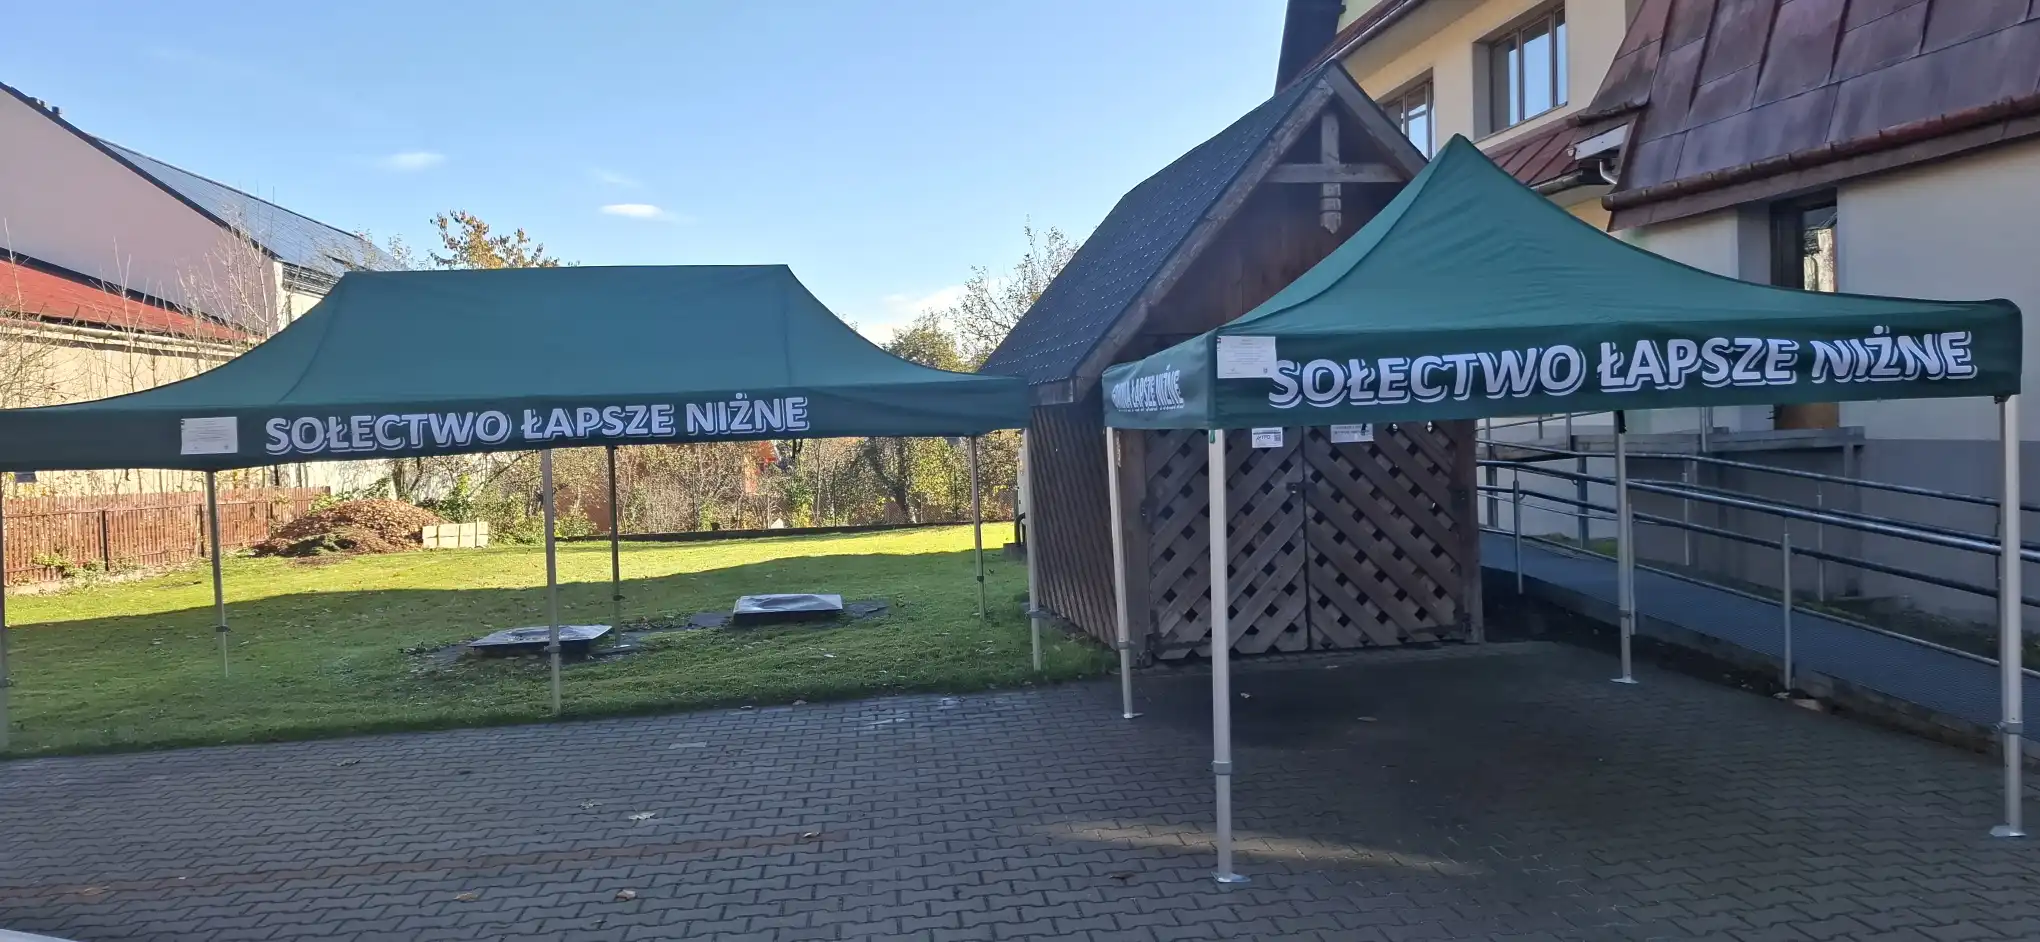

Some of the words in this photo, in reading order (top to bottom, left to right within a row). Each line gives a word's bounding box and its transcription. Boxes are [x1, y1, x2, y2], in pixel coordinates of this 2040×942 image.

[1268, 344, 1586, 408] SOŁECTWO
[1597, 336, 1798, 391] ŁAPSZE
[1810, 325, 1978, 383] NIŻNE
[265, 410, 512, 454] SOŁECTWO
[520, 403, 675, 440] ŁAPSZE
[685, 392, 809, 435] NIŻNE
